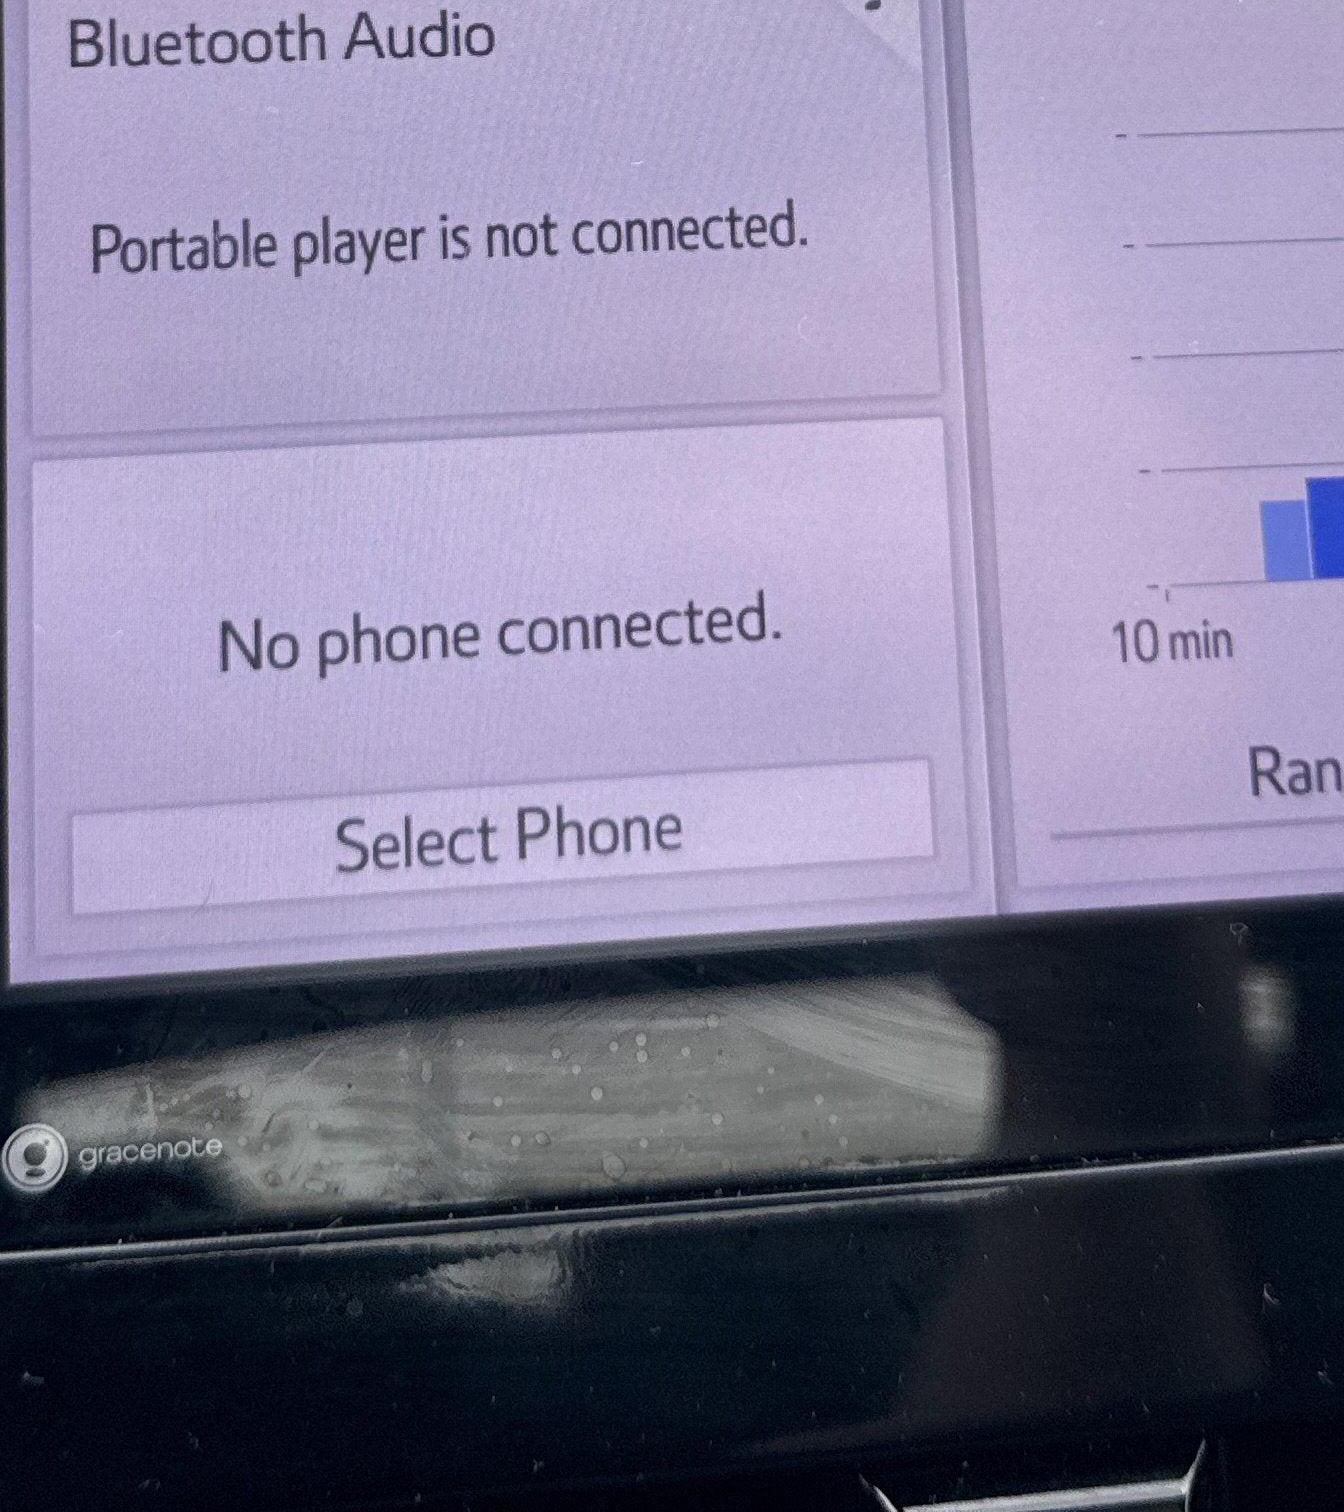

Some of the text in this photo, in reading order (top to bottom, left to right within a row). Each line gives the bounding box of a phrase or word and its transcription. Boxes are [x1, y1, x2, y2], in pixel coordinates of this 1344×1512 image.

[69, 9, 495, 69] Bluetooth Audio
[91, 198, 809, 278] Portable player is not connected.
[218, 589, 782, 680] No phone connected.
[1112, 618, 1234, 664] 10 min
[335, 804, 682, 874] Select Phone
[78, 1137, 224, 1172] gracenote
